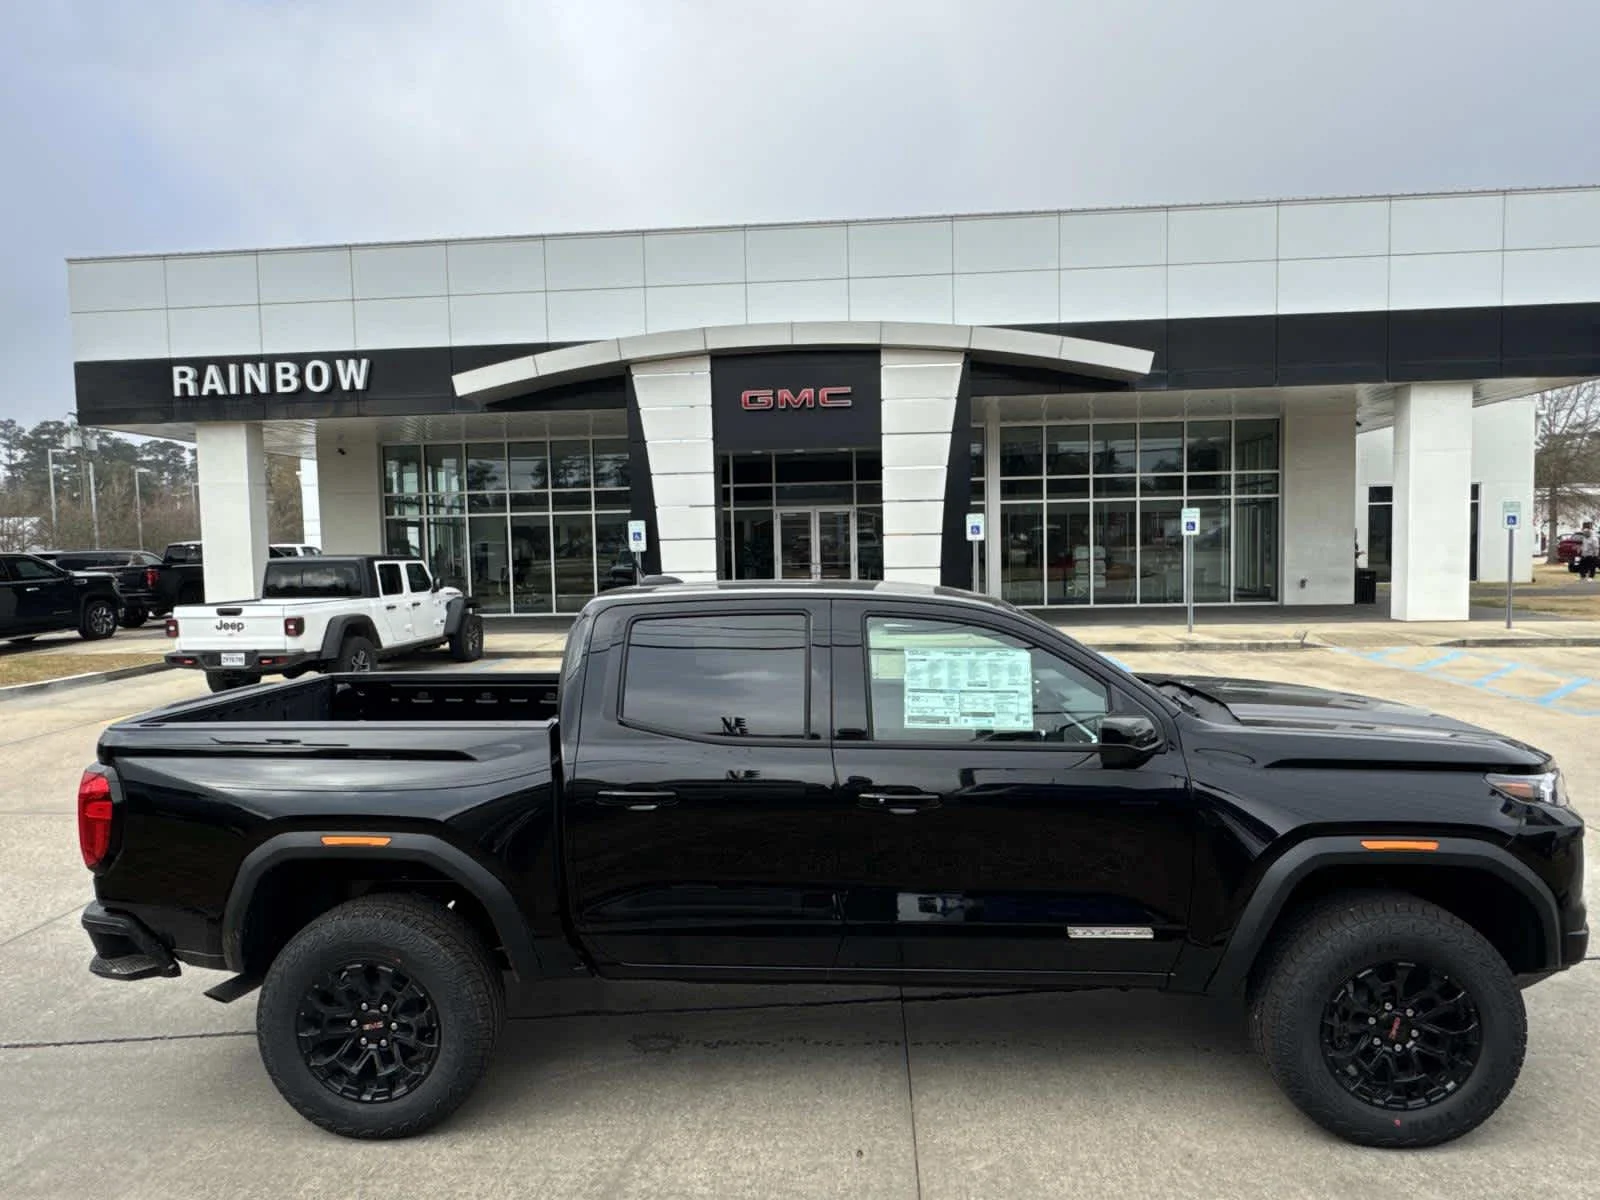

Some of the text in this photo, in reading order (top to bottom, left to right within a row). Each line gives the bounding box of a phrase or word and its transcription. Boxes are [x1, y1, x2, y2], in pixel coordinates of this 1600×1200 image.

[172, 358, 369, 397] RAINBOW
[741, 386, 852, 410] GMC
[216, 620, 244, 632] Jeep
